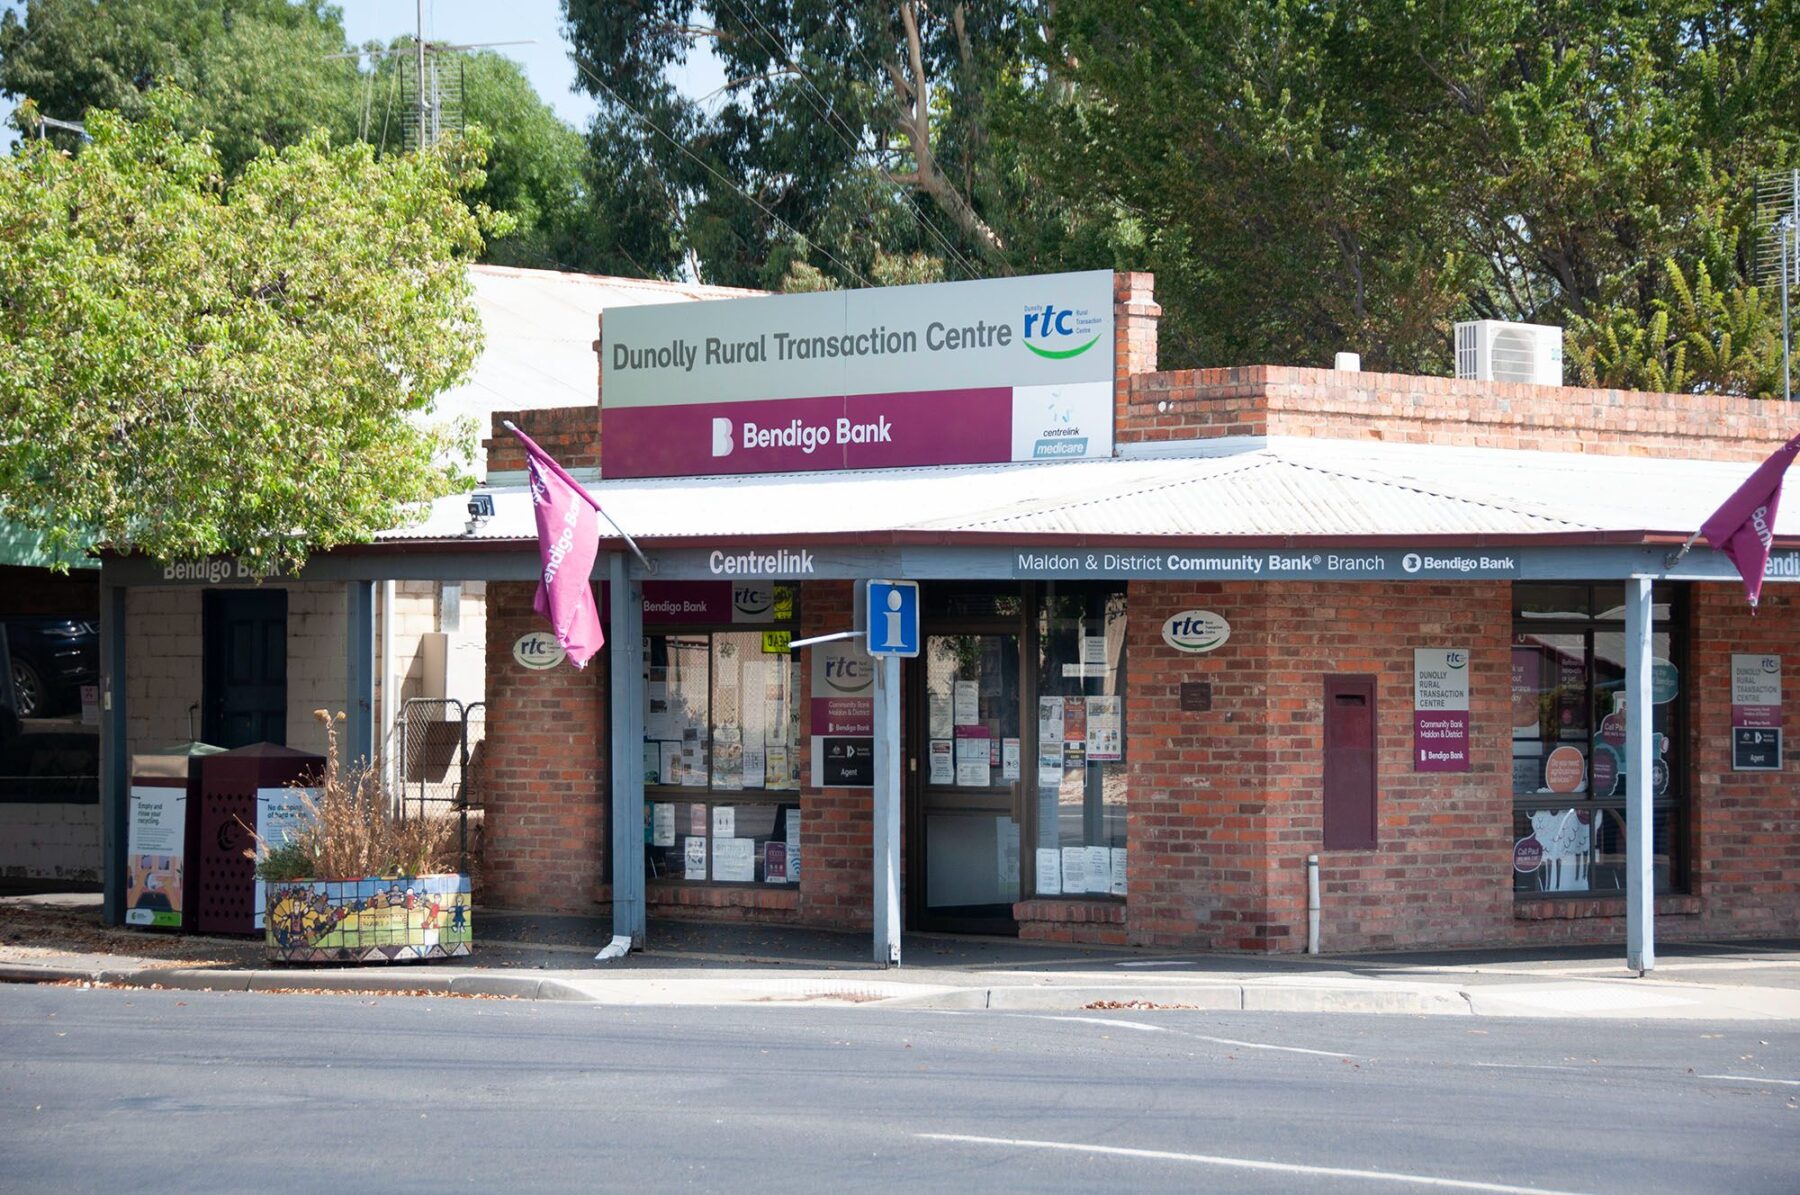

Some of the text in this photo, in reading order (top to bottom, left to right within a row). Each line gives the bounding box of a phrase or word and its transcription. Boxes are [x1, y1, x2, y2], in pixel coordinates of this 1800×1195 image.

[1024, 305, 1073, 338] rtc
[613, 320, 1012, 372] Dunolly Rural Transaction Centre
[743, 419, 831, 454] Bendigo
[836, 415, 893, 444] Bank
[1043, 427, 1080, 437] centrelink
[1037, 441, 1084, 454] medicare
[543, 527, 574, 589] endigo
[709, 549, 815, 574] Centrelink
[1018, 554, 1079, 570] Maldon
[1085, 555, 1098, 570] &
[1104, 554, 1162, 570] District
[1167, 555, 1263, 573] Community
[1327, 554, 1385, 570] Branch
[1424, 556, 1515, 572] Bendigo Bank
[1764, 552, 1800, 575] endi
[163, 557, 281, 583] Bendigo Bk
[734, 587, 759, 604] rtc
[643, 600, 707, 615] Bendigo Bank
[1172, 616, 1204, 635] rtc
[521, 637, 546, 654] rtc
[826, 656, 857, 677] rtc
[1419, 671, 1447, 680] DUNOLLY
[1419, 680, 1440, 688] RURAL
[1420, 690, 1464, 698] TRANSACTION
[1420, 699, 1445, 707] CENTRE
[836, 723, 857, 733] Bendigo
[857, 723, 870, 731] Bank
[1420, 720, 1463, 729] Community Bank
[1420, 730, 1439, 738] Maldon
[1445, 730, 1463, 738] District
[1428, 751, 1449, 761] Bendigo
[1450, 751, 1464, 760] Bank
[1750, 754, 1765, 763] Agent
[841, 768, 858, 777] Agent
